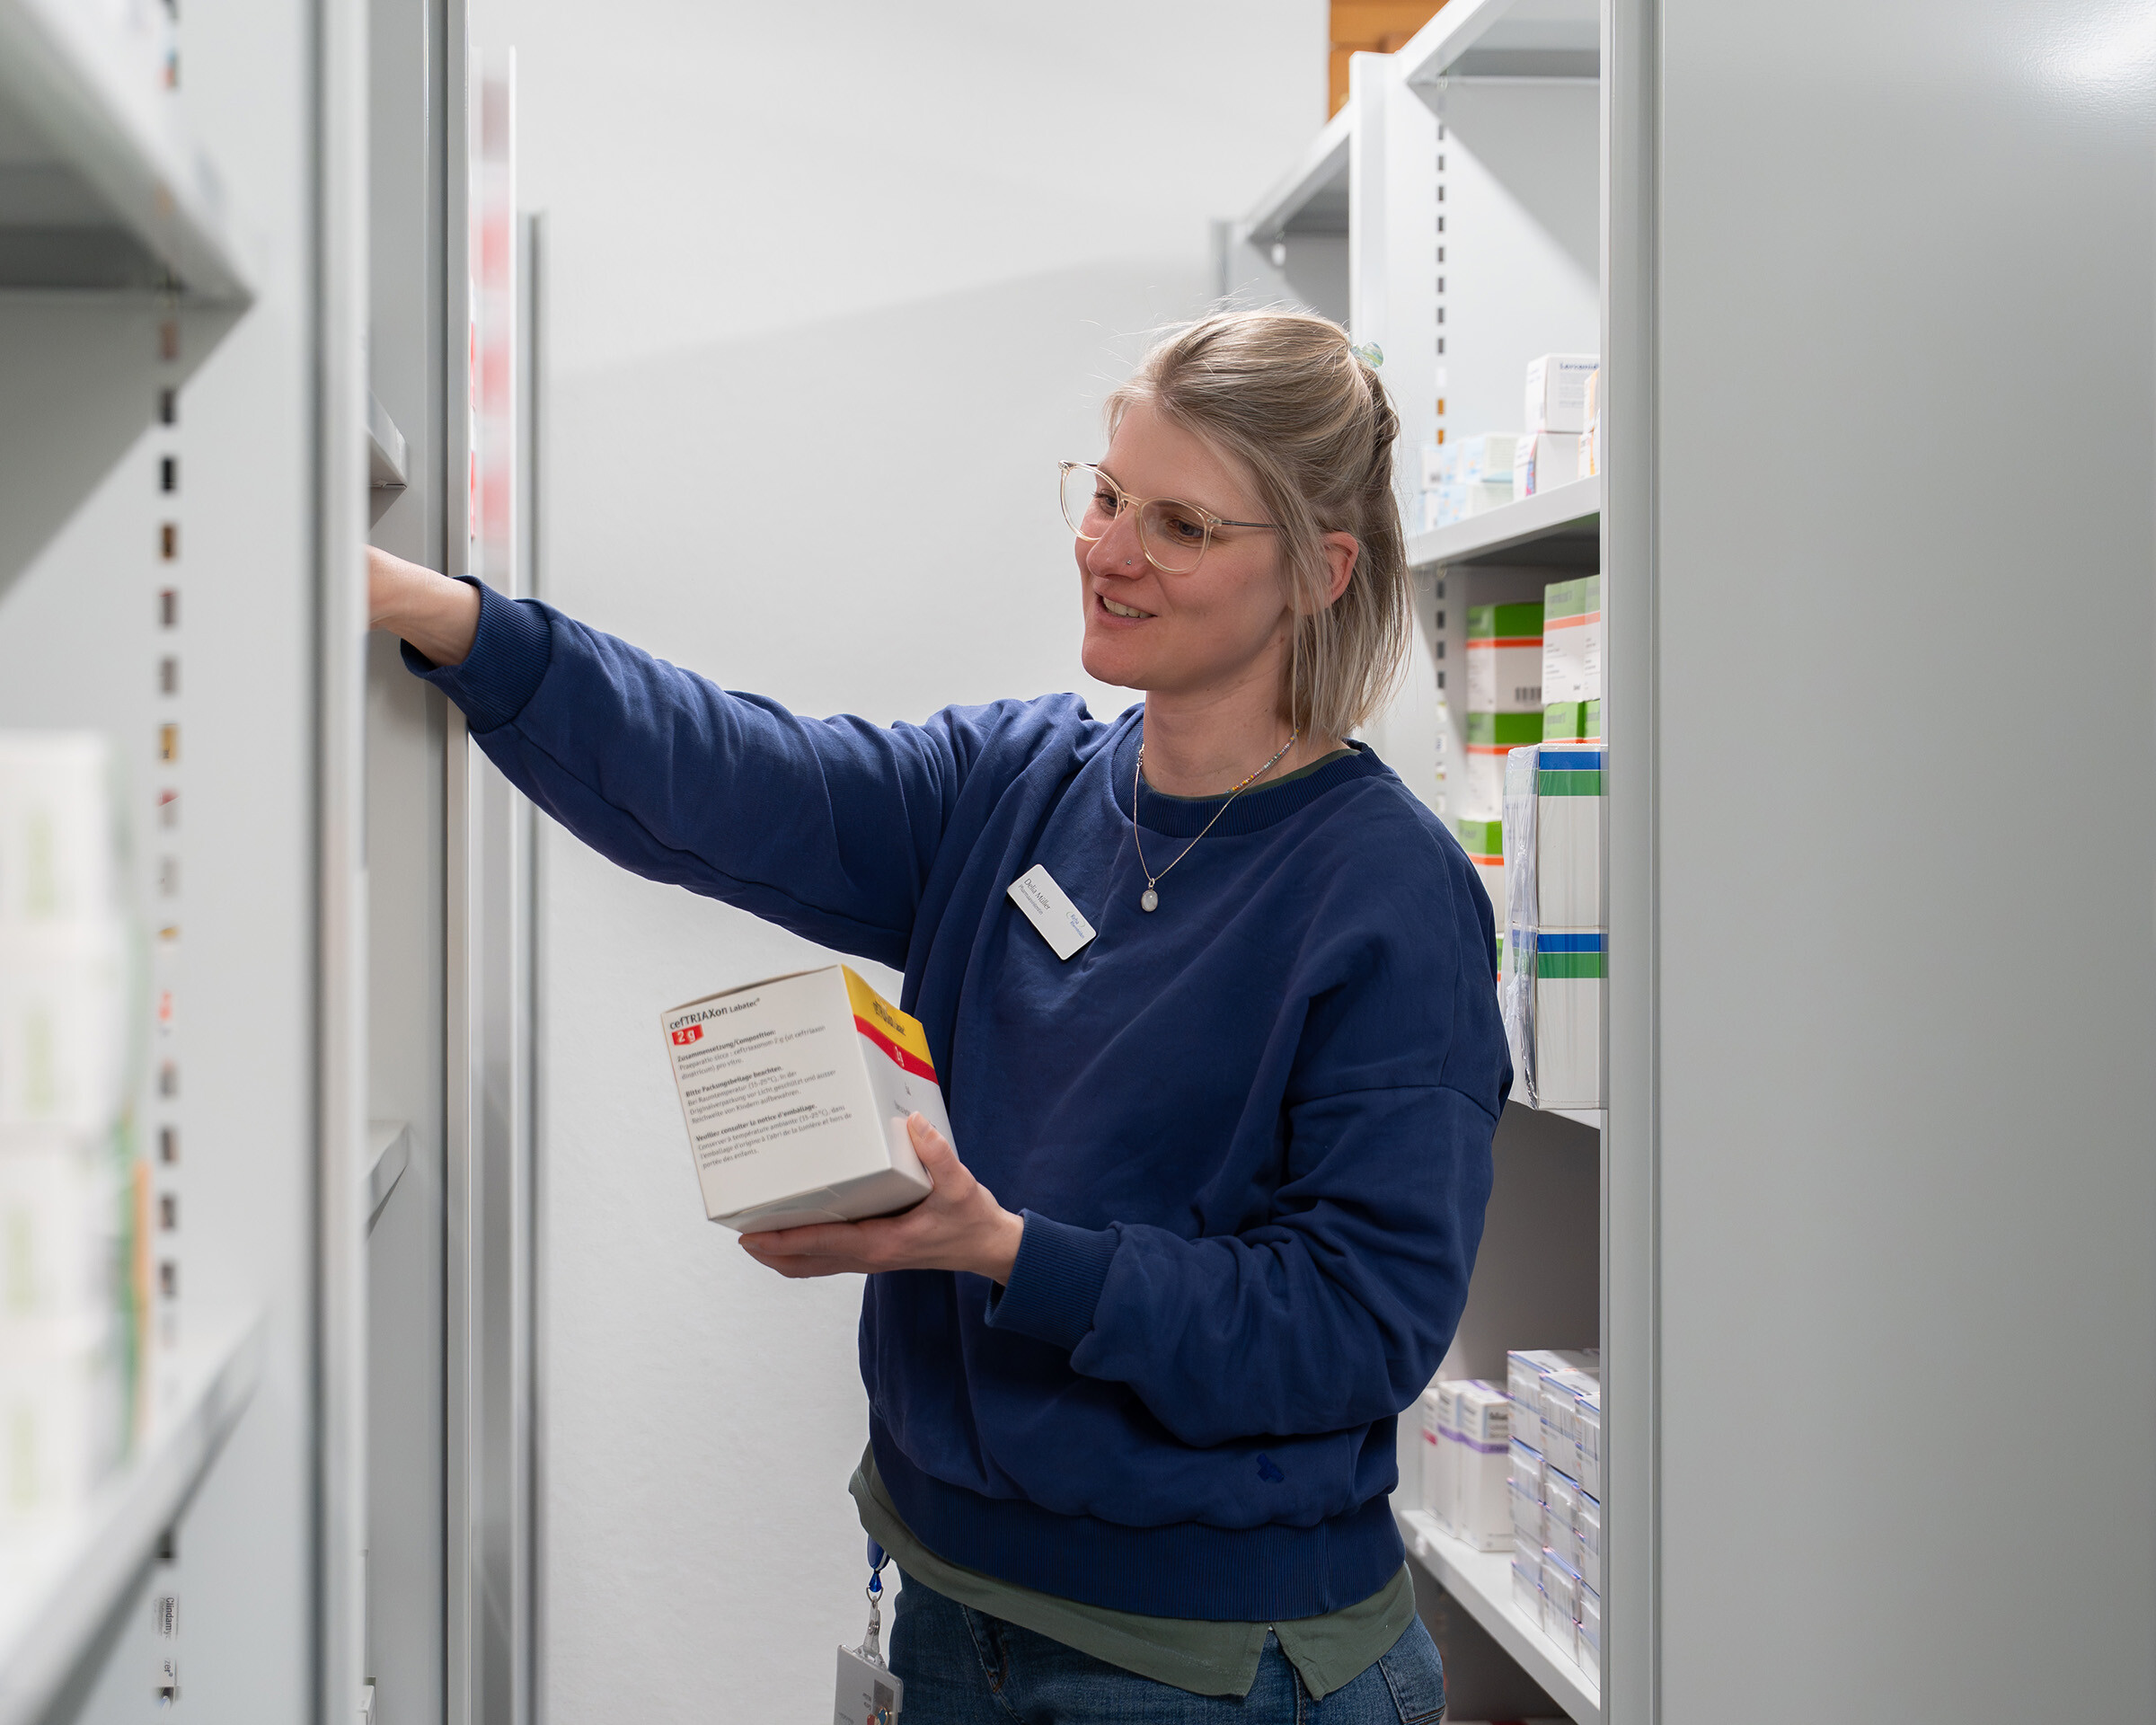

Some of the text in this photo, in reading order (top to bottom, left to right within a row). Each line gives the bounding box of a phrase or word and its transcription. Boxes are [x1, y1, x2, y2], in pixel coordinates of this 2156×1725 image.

[1023, 878, 1051, 910] Delia Müller
[670, 1008, 728, 1029] cefTRIAXon
[676, 1030, 696, 1043] 2 g
[685, 1066, 783, 1097] Bitte Packungsbeilage beachten.
[757, 1115, 776, 1124] notice
